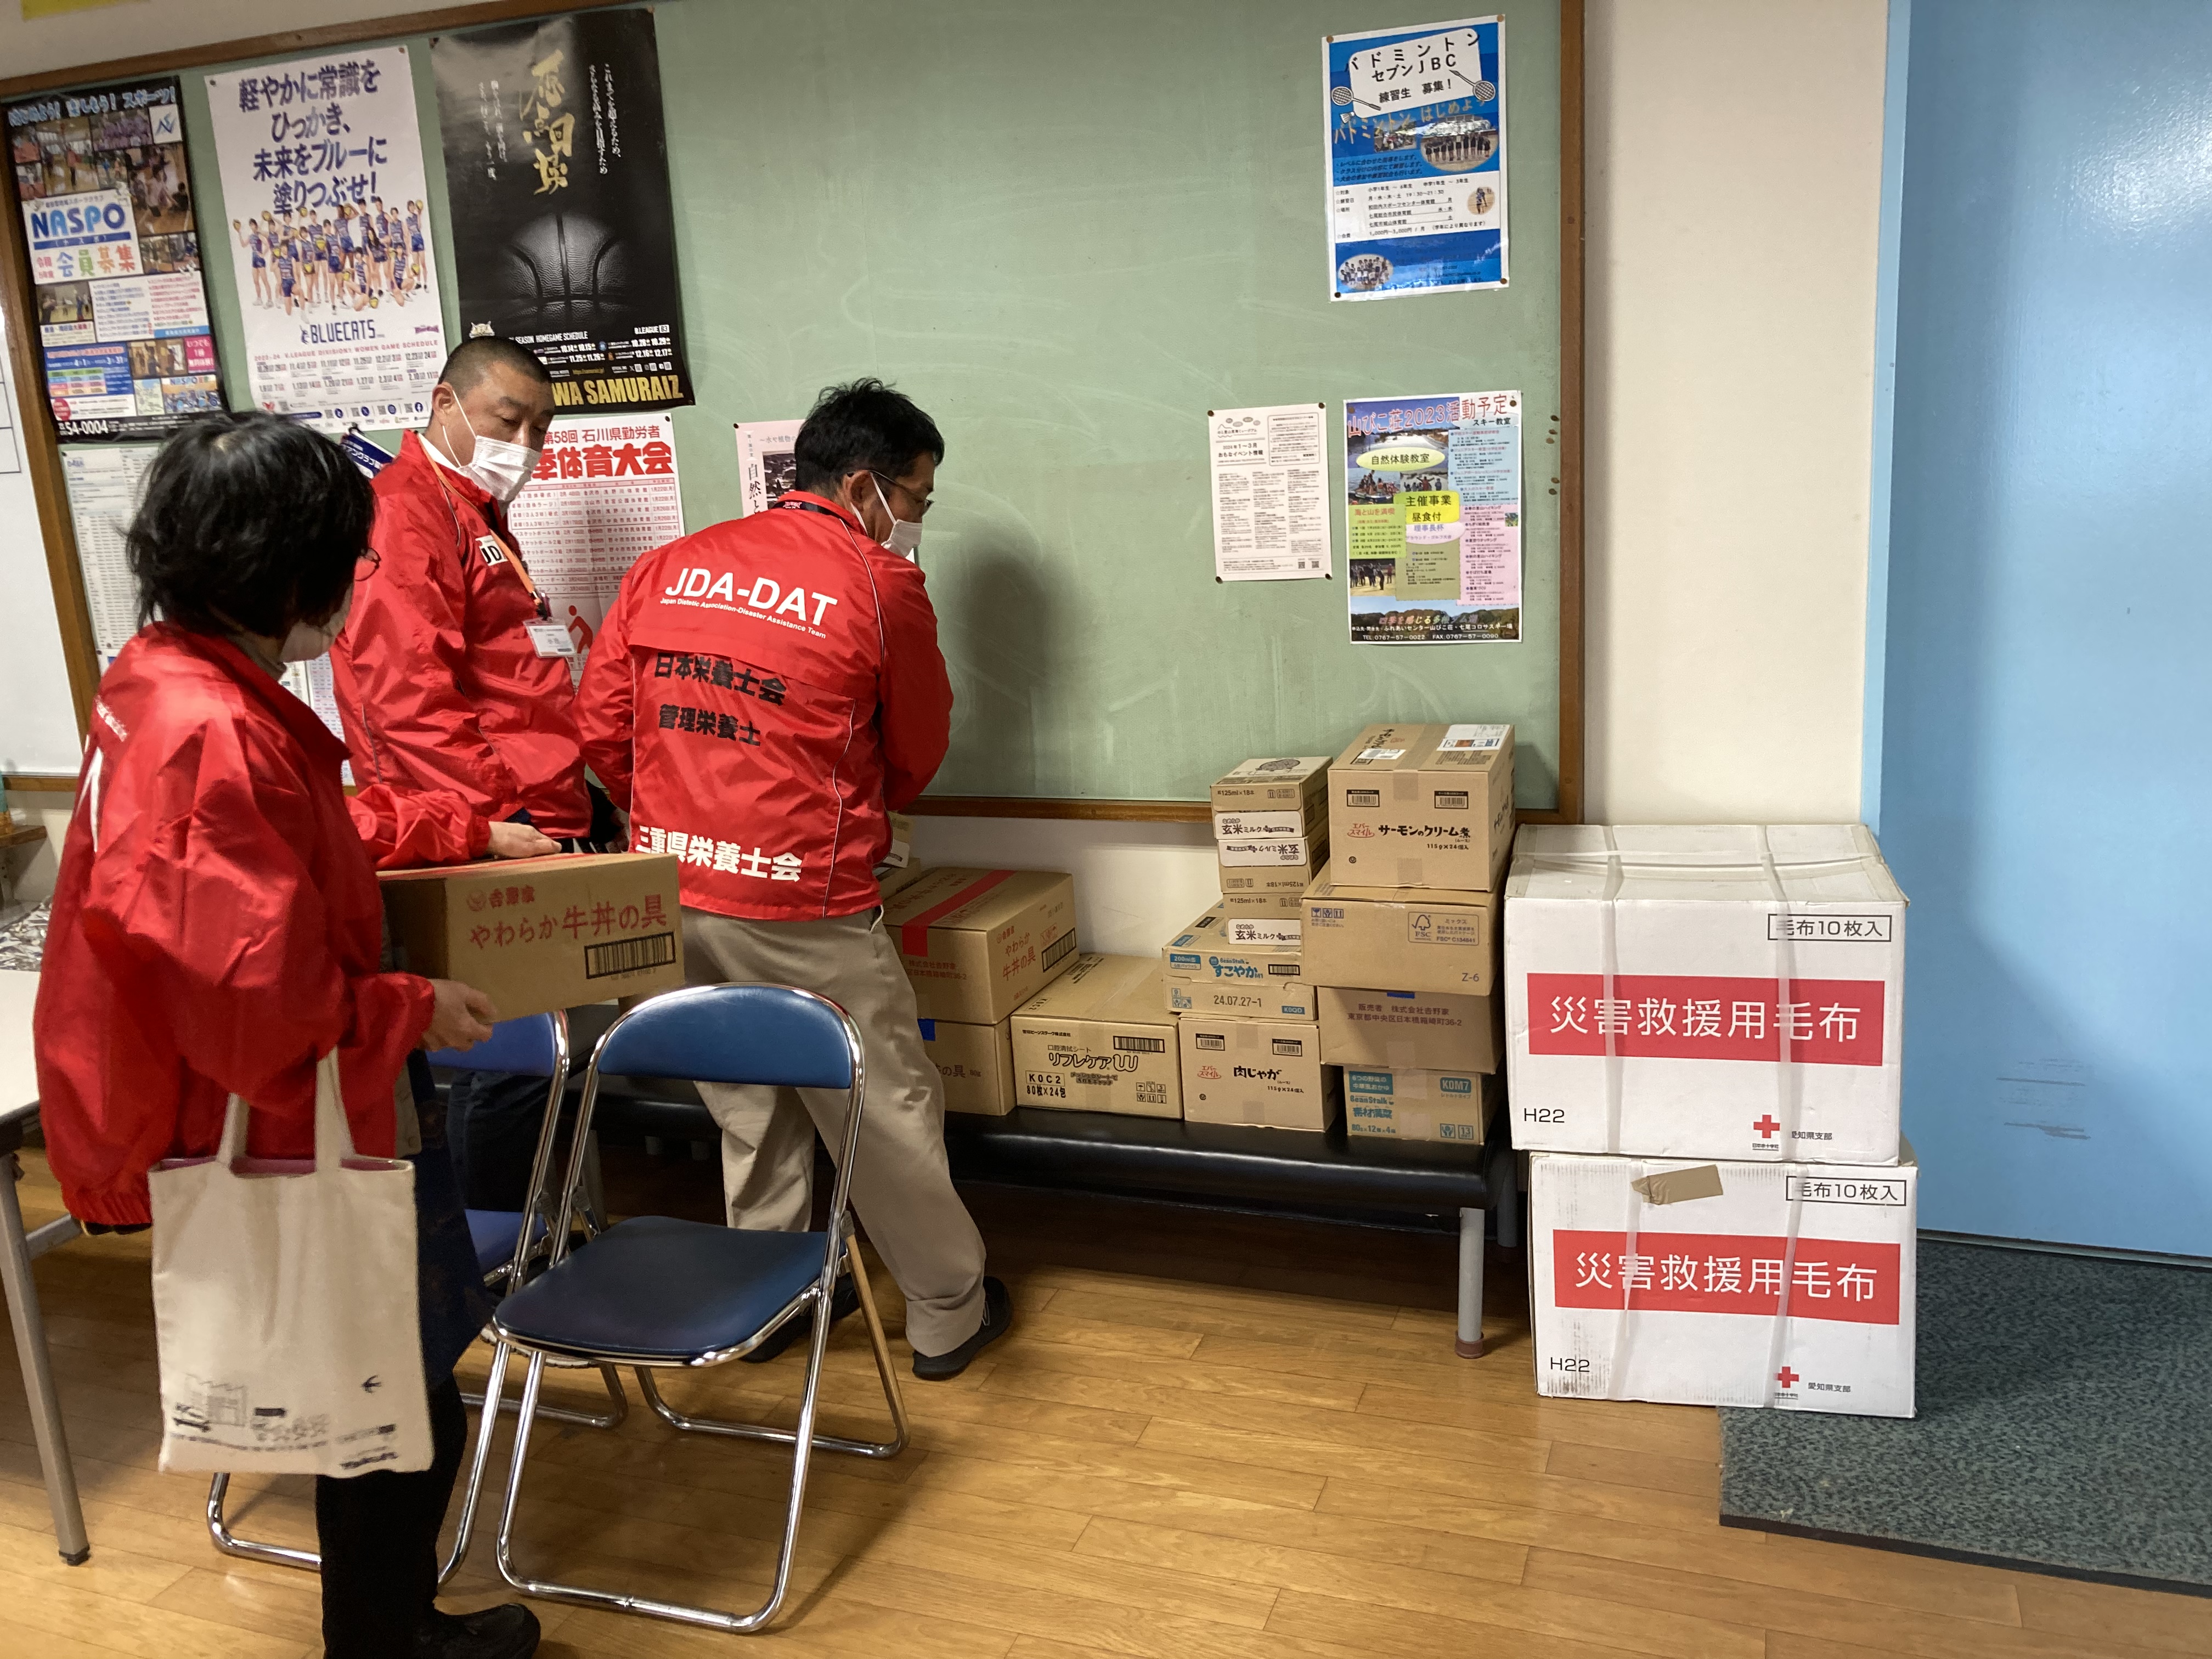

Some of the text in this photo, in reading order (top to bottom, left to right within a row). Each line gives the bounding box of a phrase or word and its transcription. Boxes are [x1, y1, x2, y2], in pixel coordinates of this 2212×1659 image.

[1345, 33, 1479, 72] バドミントン
[1372, 54, 1456, 82] セブンJBC
[239, 59, 381, 112] 軽やかに常識を
[1379, 78, 1452, 104] 練習生 募集!
[272, 102, 351, 143] ひっかき、
[253, 136, 387, 182] 未来をブルーに
[273, 171, 377, 215] 塗りつぶせ!
[31, 202, 126, 239] NASPO
[57, 244, 136, 278] 会員募集
[309, 319, 376, 343] BLUECATS
[535, 334, 562, 342] HOMEGAME
[563, 331, 588, 341] SCHEDULE
[654, 348, 668, 357] 12.17
[584, 374, 684, 405] SAMURAIZ
[1348, 394, 1507, 438] 山びこ荘2023活動予定
[1473, 417, 1511, 426] スキー教室
[66, 420, 109, 435] 54-0004
[544, 425, 661, 445] 第58回 石川県勤労者
[1218, 450, 1264, 458] おもなイベント情報
[1372, 453, 1430, 465] 自然体験教室
[1406, 495, 1452, 507] 主催事業
[1412, 512, 1442, 522] 昼食付
[665, 568, 838, 627] JDA-DAT
[660, 597, 676, 606] Japan
[678, 598, 700, 607] Dietetic
[767, 614, 806, 632] Assistance
[808, 627, 827, 639] Team
[654, 652, 787, 706] 日本栄養士会
[658, 703, 761, 747] 管理栄養士
[1221, 824, 1262, 835] 玄米ミルク
[1349, 828, 1373, 837] スマイル
[1378, 825, 1471, 838] サーモンのクリーム煮
[635, 825, 803, 882] 三重県栄養士会
[1259, 844, 1300, 854] 玄米ミルク
[1235, 930, 1276, 940] 玄米ミルク
[1775, 919, 1883, 938] 毛布10枚入
[1005, 932, 1031, 957] やわらか
[1002, 945, 1036, 981] 牛丼の具
[1213, 964, 1258, 978] すこやか
[1462, 972, 1480, 982] Z-6
[1214, 995, 1262, 1008] 24.07.27-1
[1347, 1013, 1462, 1026] 東京都中央区日本橋箱崎町36-2
[1549, 995, 1861, 1042] 災害救援用毛布
[1047, 1044, 1092, 1053] 口腔清拭シート
[1233, 1065, 1282, 1081] 肉じゃが
[1352, 1075, 1387, 1083] 6つの野菜の
[1026, 1085, 1066, 1098] 80枚×24包
[1352, 1083, 1390, 1091] 中華風おかゆ
[1350, 1095, 1387, 1104] BeanStalk
[1523, 1108, 1565, 1124] H22
[1796, 1181, 1898, 1202] 毛布10枚入
[1575, 1251, 1878, 1302] 災害救援用毛布
[1550, 1356, 1590, 1373] H22
[1808, 1382, 1851, 1393] 愛知県支部
